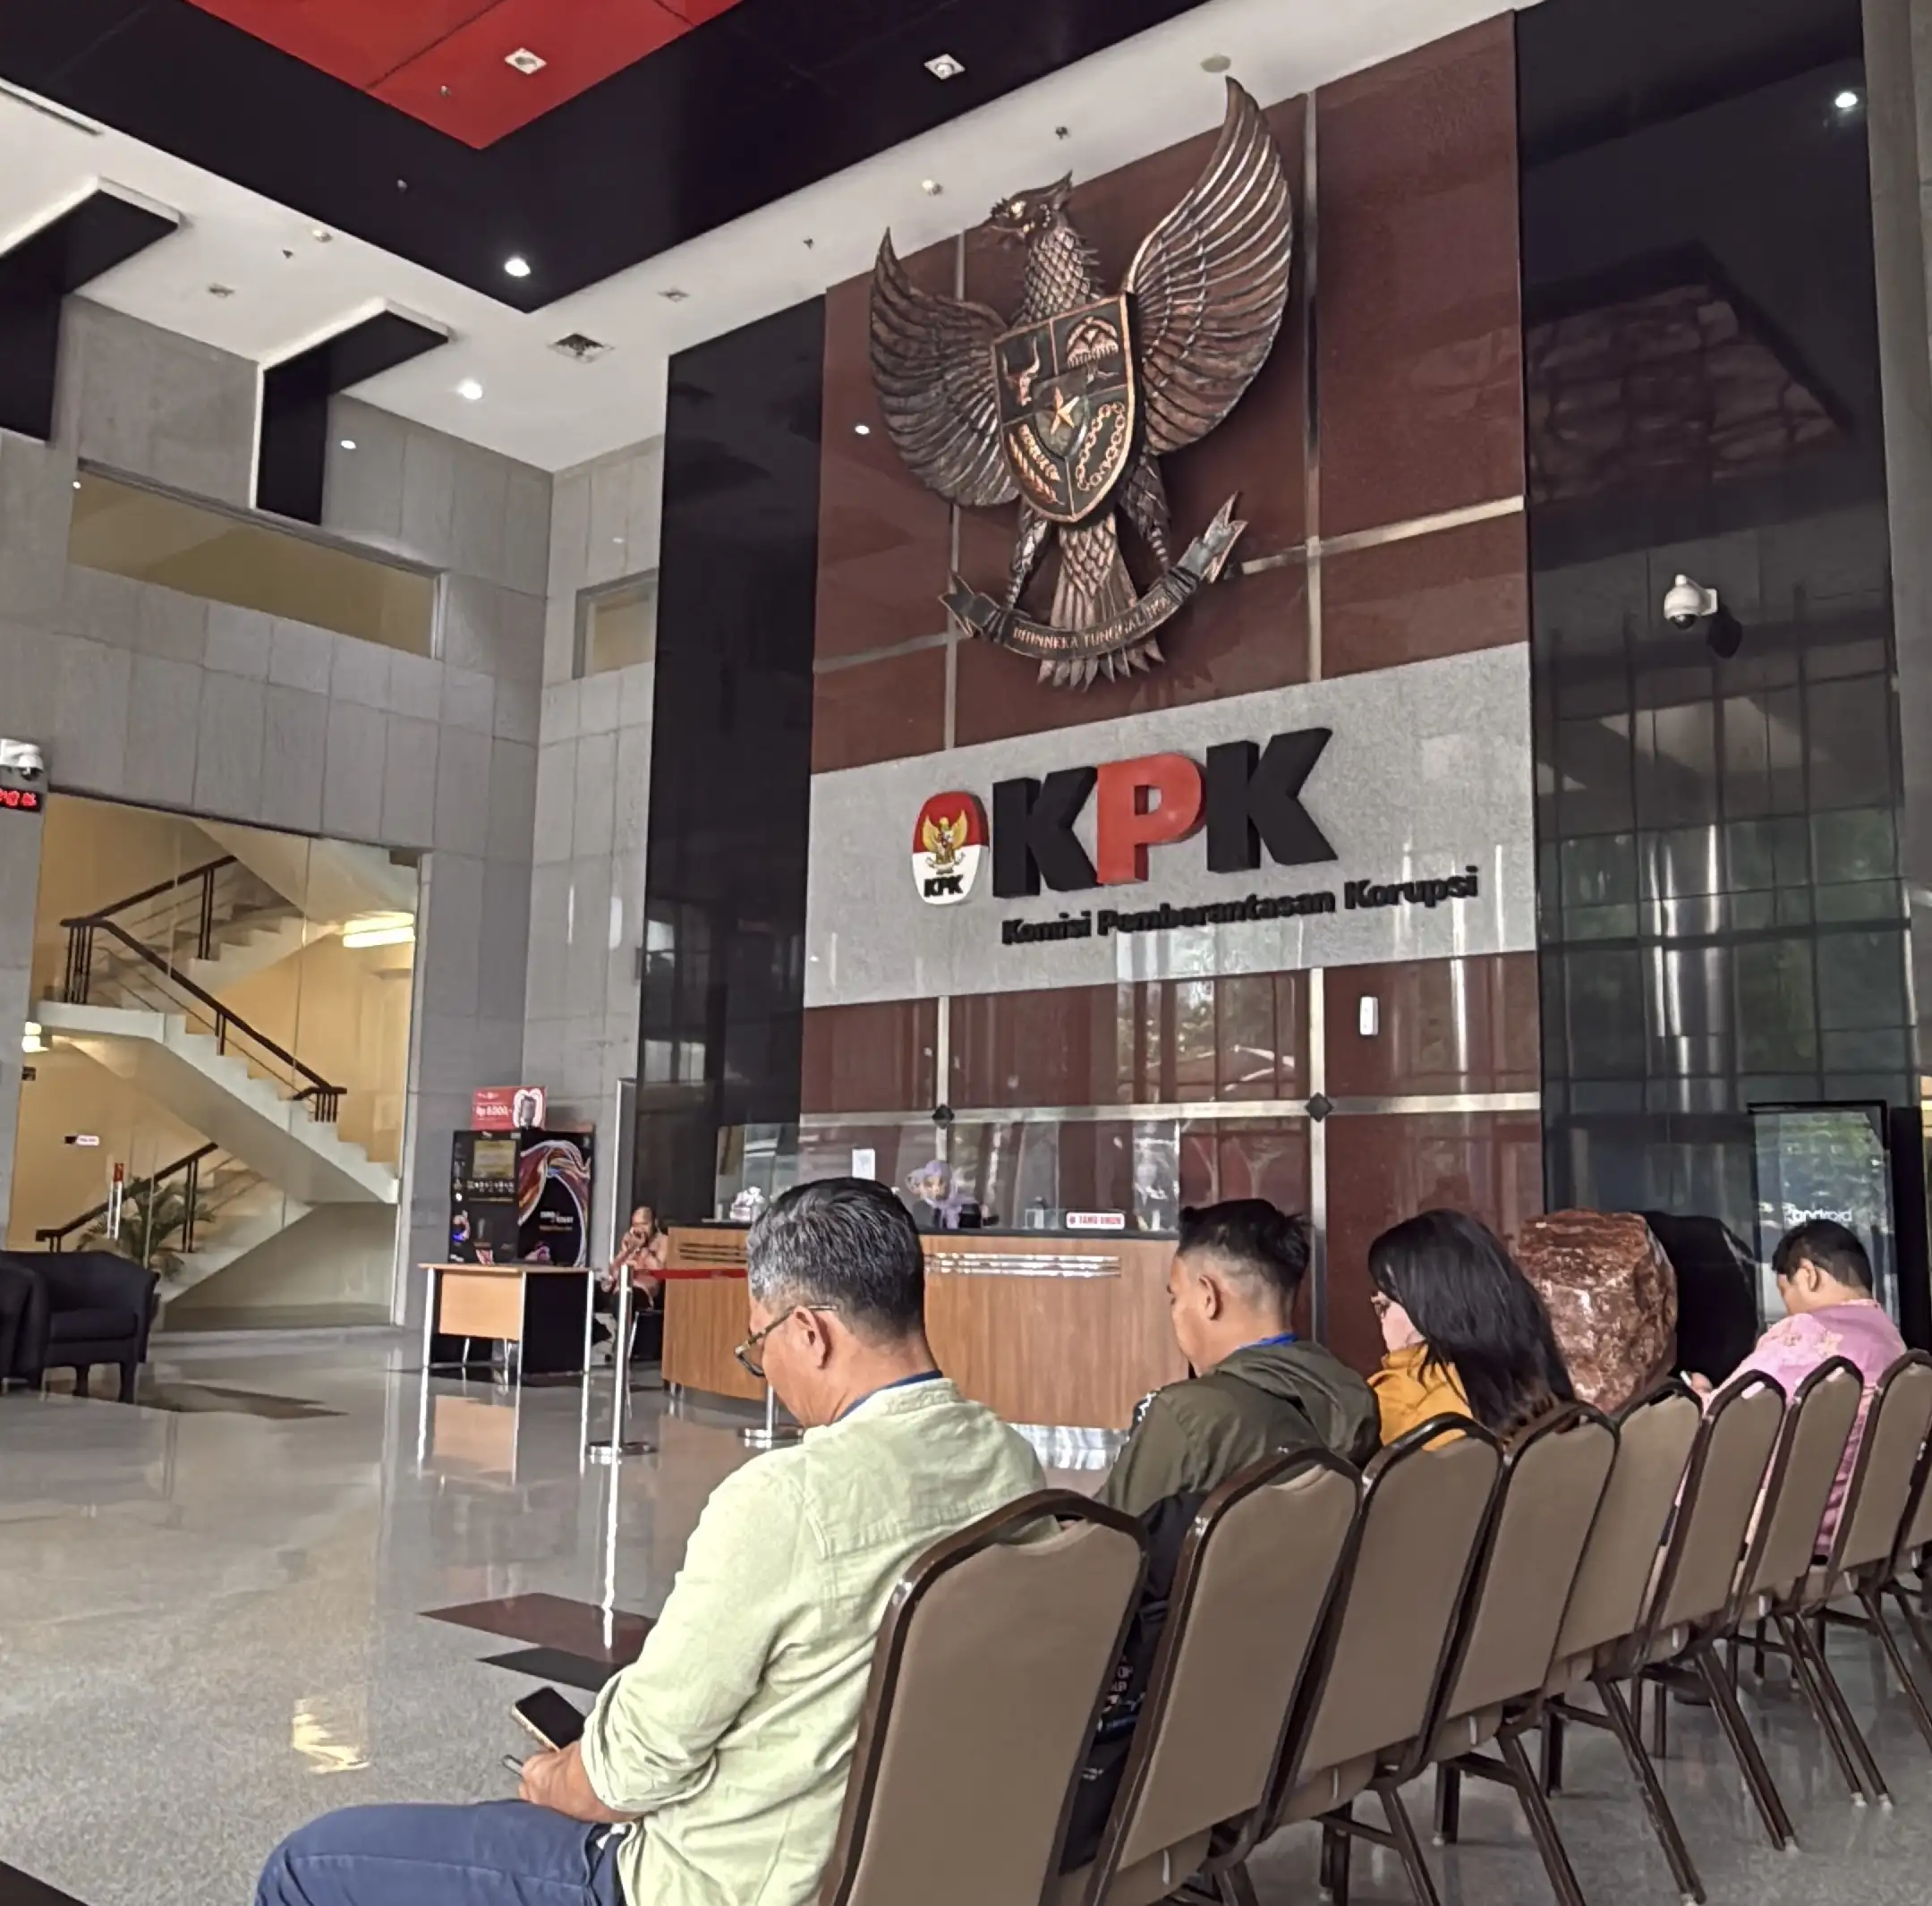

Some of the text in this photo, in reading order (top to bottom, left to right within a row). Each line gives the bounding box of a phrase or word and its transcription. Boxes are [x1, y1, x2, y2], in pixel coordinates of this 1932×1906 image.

[992, 727, 1339, 898] KPK
[923, 874, 964, 898] KPK
[1001, 865, 1479, 946] Komisi Pemberantasan Korupsi
